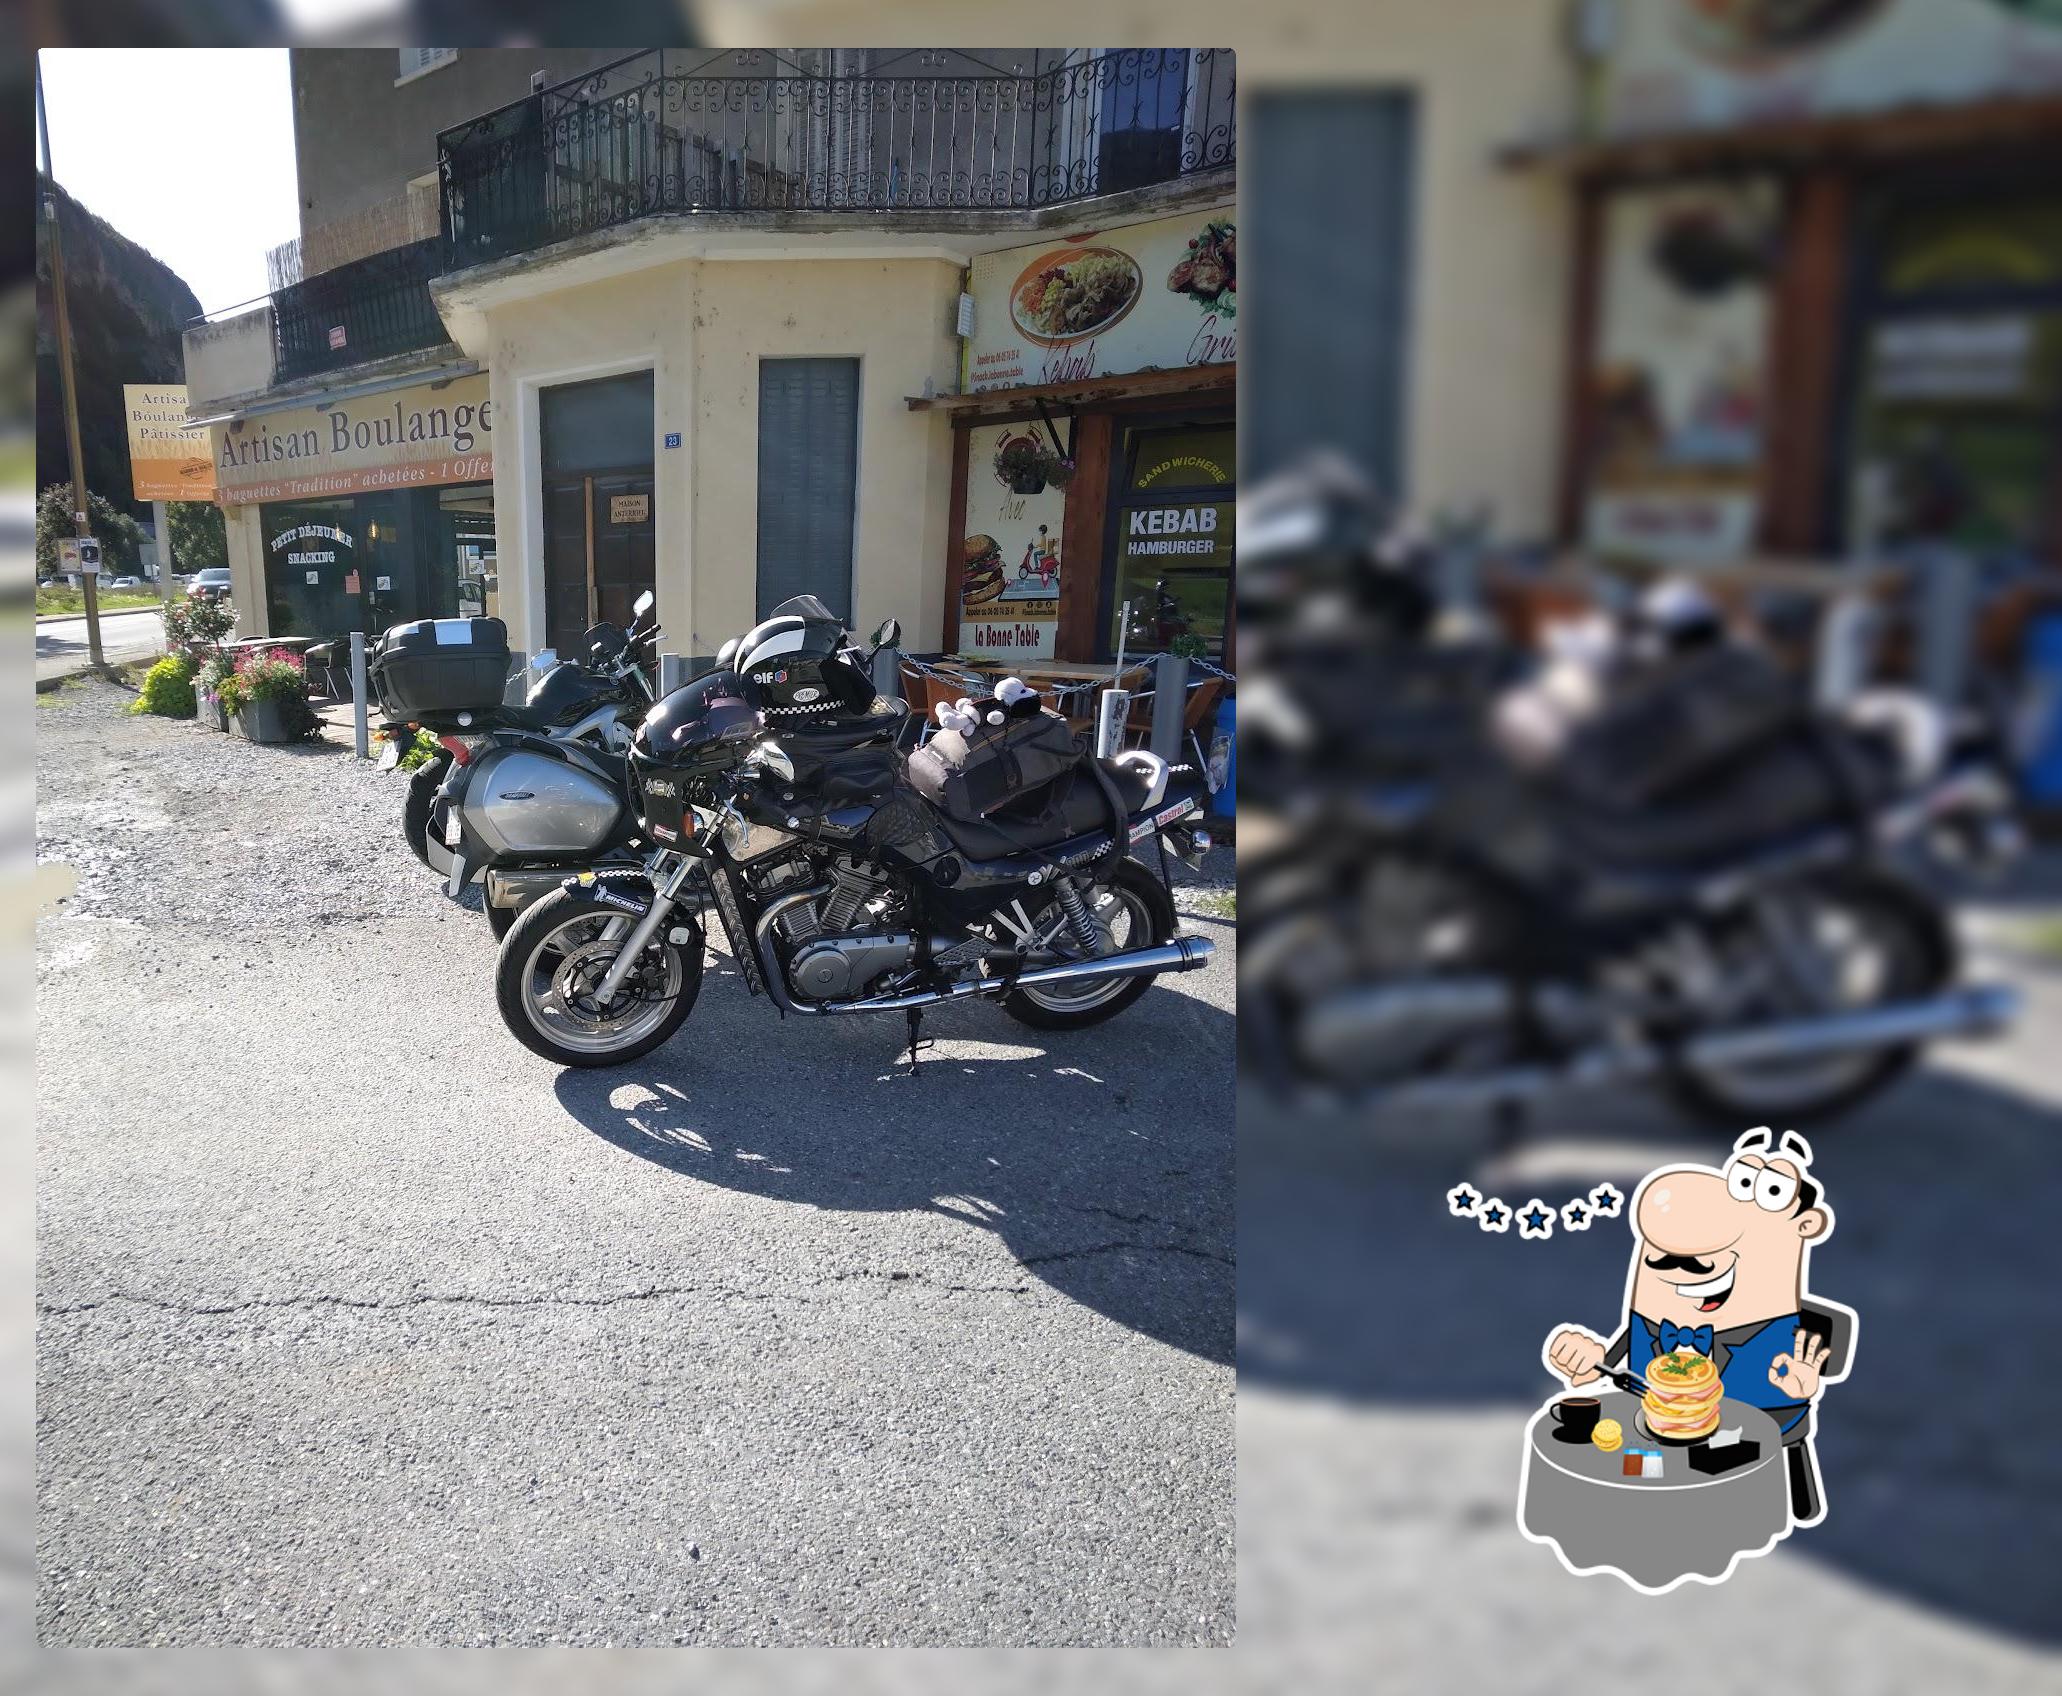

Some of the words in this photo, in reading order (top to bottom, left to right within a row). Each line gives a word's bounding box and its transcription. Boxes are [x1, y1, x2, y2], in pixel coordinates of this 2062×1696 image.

[140, 427, 204, 440] Pâtissier
[668, 436, 678, 446] 23
[219, 424, 320, 468] Artisan
[362, 465, 425, 487] achetées
[1137, 456, 1226, 488] SANDWICHERIE
[618, 499, 642, 509] MAISON
[1129, 507, 1218, 535] KEBAB
[270, 528, 297, 553] PETIT
[1127, 539, 1215, 555] HAMBURGER
[287, 551, 336, 565] SNACKING
[986, 624, 1013, 647] Bonne
[1015, 623, 1040, 647] Table
[753, 671, 774, 684] elf
[1158, 804, 1185, 825] Castrol
[606, 894, 646, 912] MICHELIN
